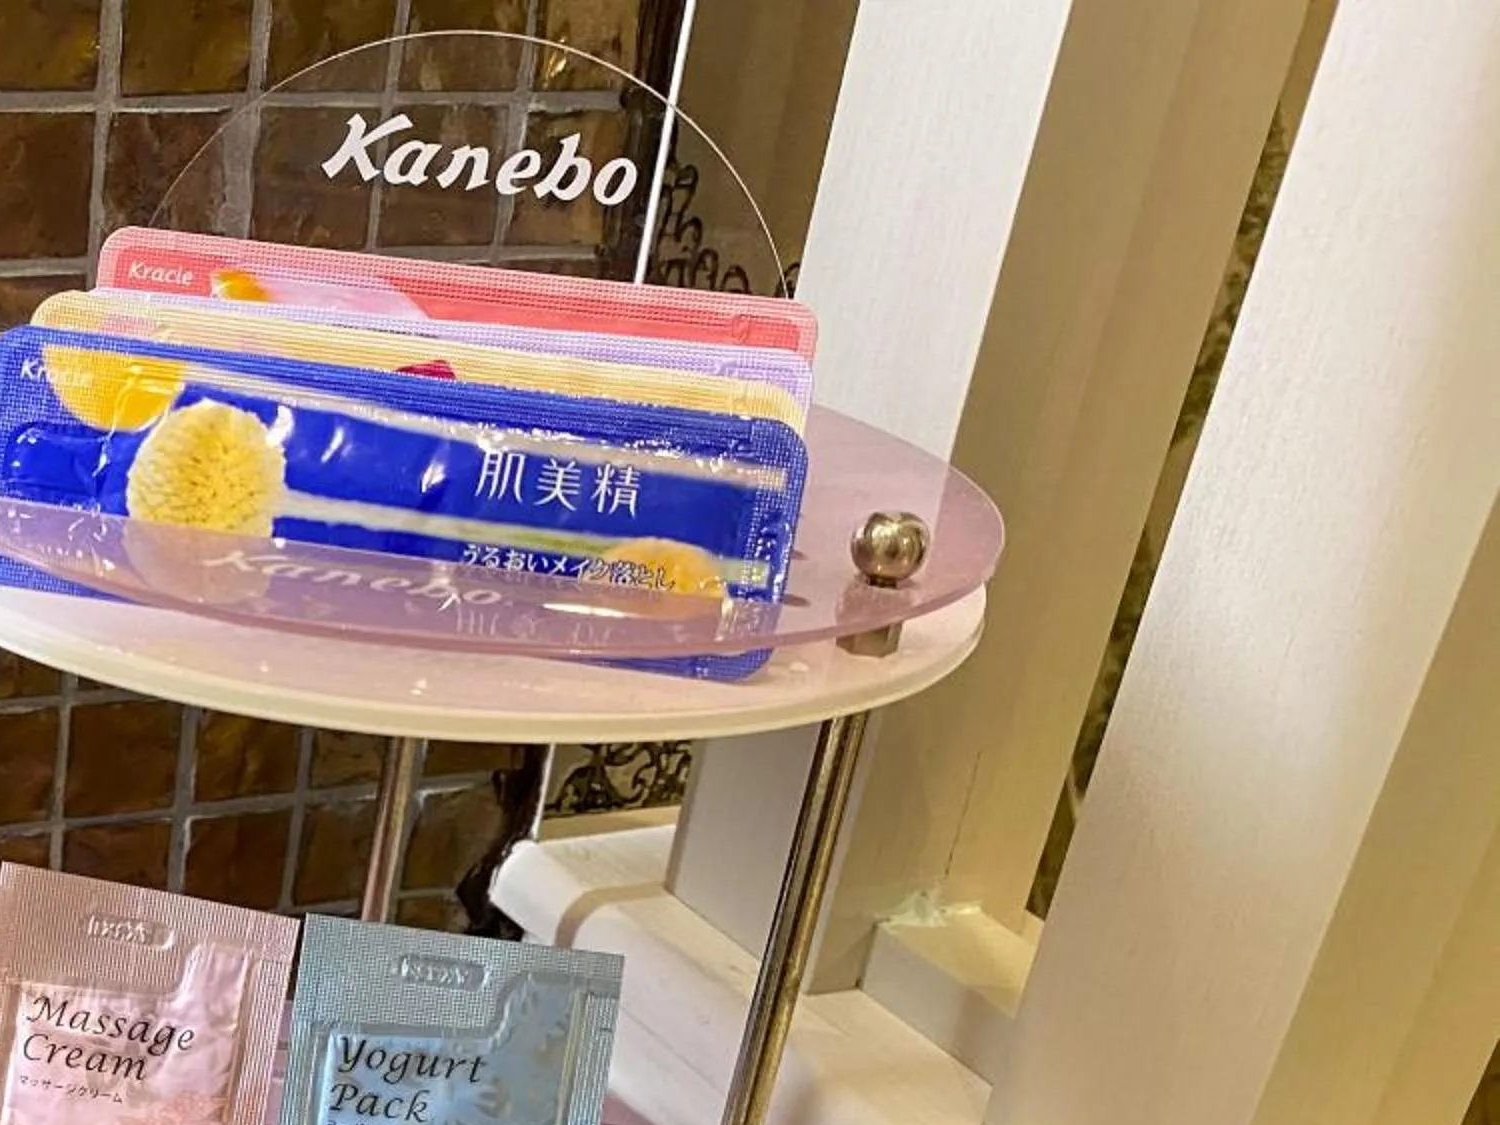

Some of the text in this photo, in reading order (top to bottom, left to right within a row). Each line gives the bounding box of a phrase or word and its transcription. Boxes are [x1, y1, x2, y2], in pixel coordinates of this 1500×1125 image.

[321, 112, 638, 206] Kanebo
[128, 261, 195, 287] Kracie
[474, 448, 642, 520] 肌美精
[203, 551, 502, 605] Kanebo
[462, 544, 677, 591] うるおいメイク落とし
[26, 995, 195, 1057] Massage
[23, 1033, 146, 1081] Cream
[338, 1035, 487, 1085] Yogurt
[330, 1082, 431, 1123] Pack
